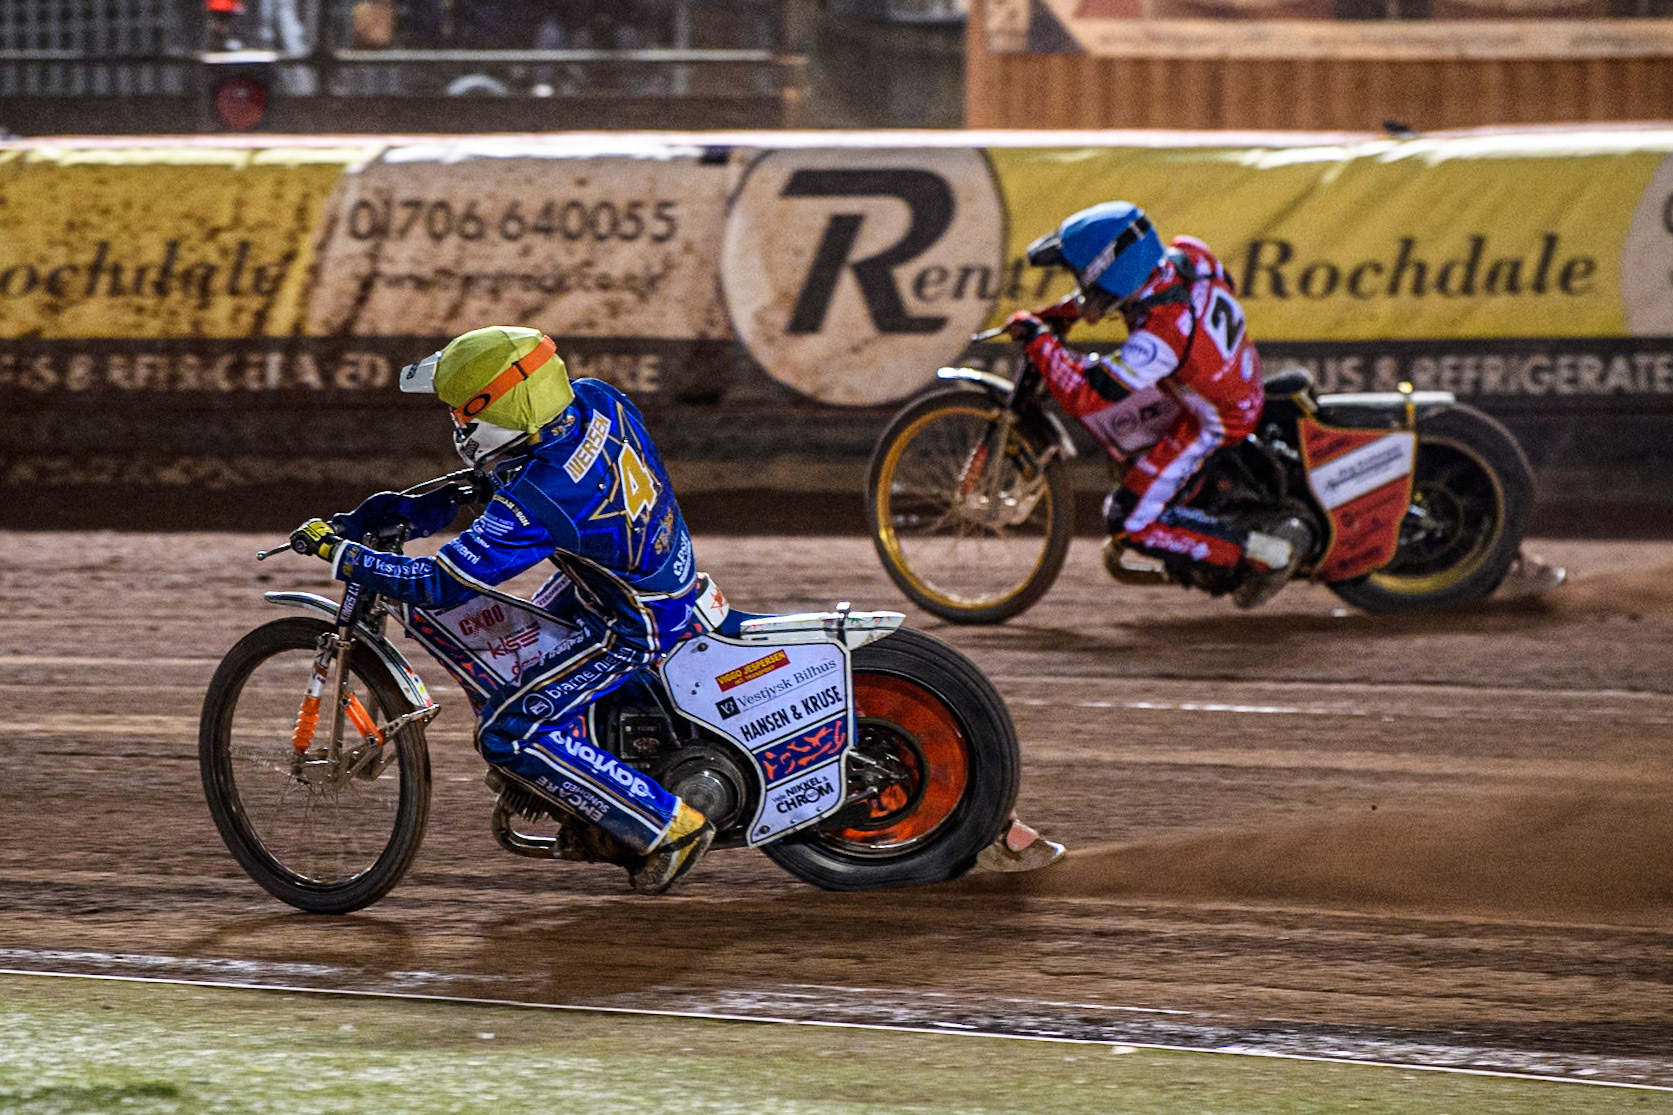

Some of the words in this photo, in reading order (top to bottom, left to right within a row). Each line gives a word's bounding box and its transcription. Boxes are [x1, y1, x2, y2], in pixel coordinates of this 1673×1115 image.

[501, 200, 677, 242] 640055
[1237, 232, 1597, 300] Rochdale
[566, 413, 609, 481] IVERSEN
[618, 442, 657, 521] 4
[717, 669, 743, 685] VIGGO
[743, 650, 786, 675] JESPERSEN
[737, 678, 793, 708] Vestjysk
[793, 660, 837, 684] Bilhus
[740, 708, 791, 742] HANSEN
[790, 704, 803, 720] &
[801, 686, 843, 715] KRUSE
[550, 730, 656, 800] daytona
[785, 777, 822, 797] NIKKEL
[536, 775, 604, 823] EMCARE
[562, 781, 610, 814] SUNDHED
[776, 782, 834, 813] CHROM
